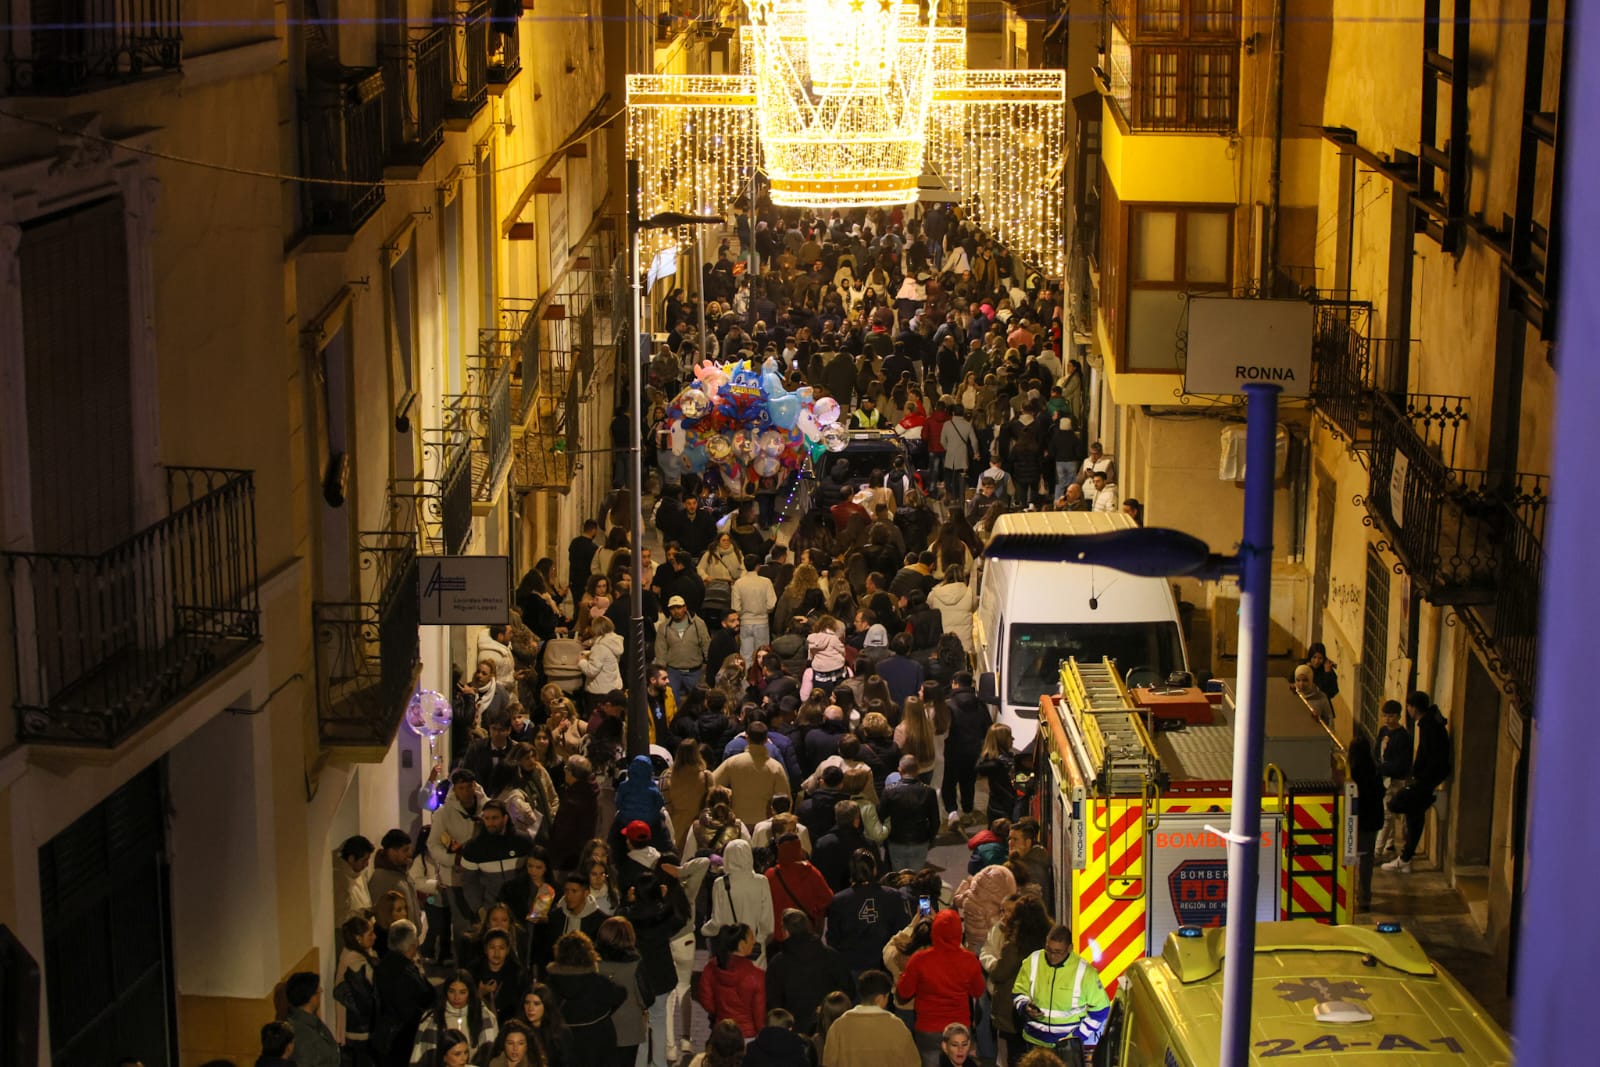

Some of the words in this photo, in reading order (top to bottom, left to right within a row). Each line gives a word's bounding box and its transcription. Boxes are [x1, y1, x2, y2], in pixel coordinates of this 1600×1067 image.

[1235, 366, 1295, 381] RONNA
[1156, 831, 1273, 849] BOMBS
[1180, 870, 1229, 880] BOMBER
[859, 898, 878, 923] 4
[1208, 901, 1218, 910] DE
[1254, 1034, 1465, 1058] 24-A1
